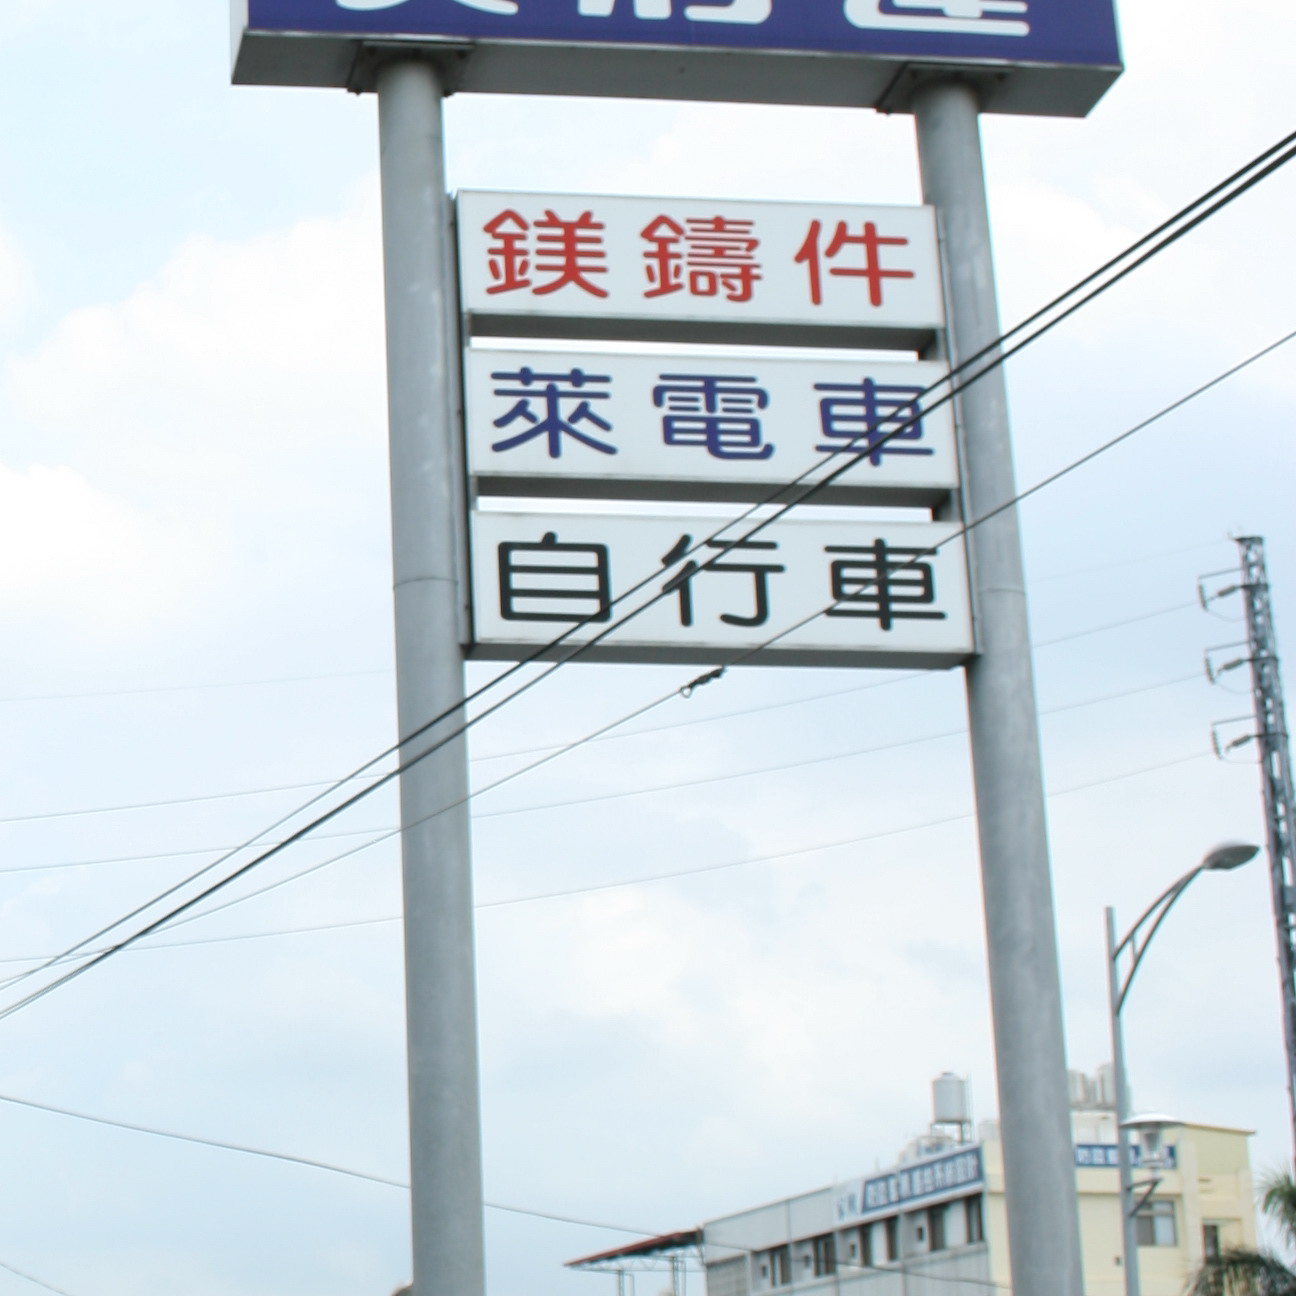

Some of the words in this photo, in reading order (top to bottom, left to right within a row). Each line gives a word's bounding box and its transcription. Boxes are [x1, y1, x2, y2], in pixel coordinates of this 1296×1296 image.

[482, 208, 915, 308] 鎂鑄件
[489, 365, 935, 467] 萊電車
[497, 531, 948, 631] 自行車
